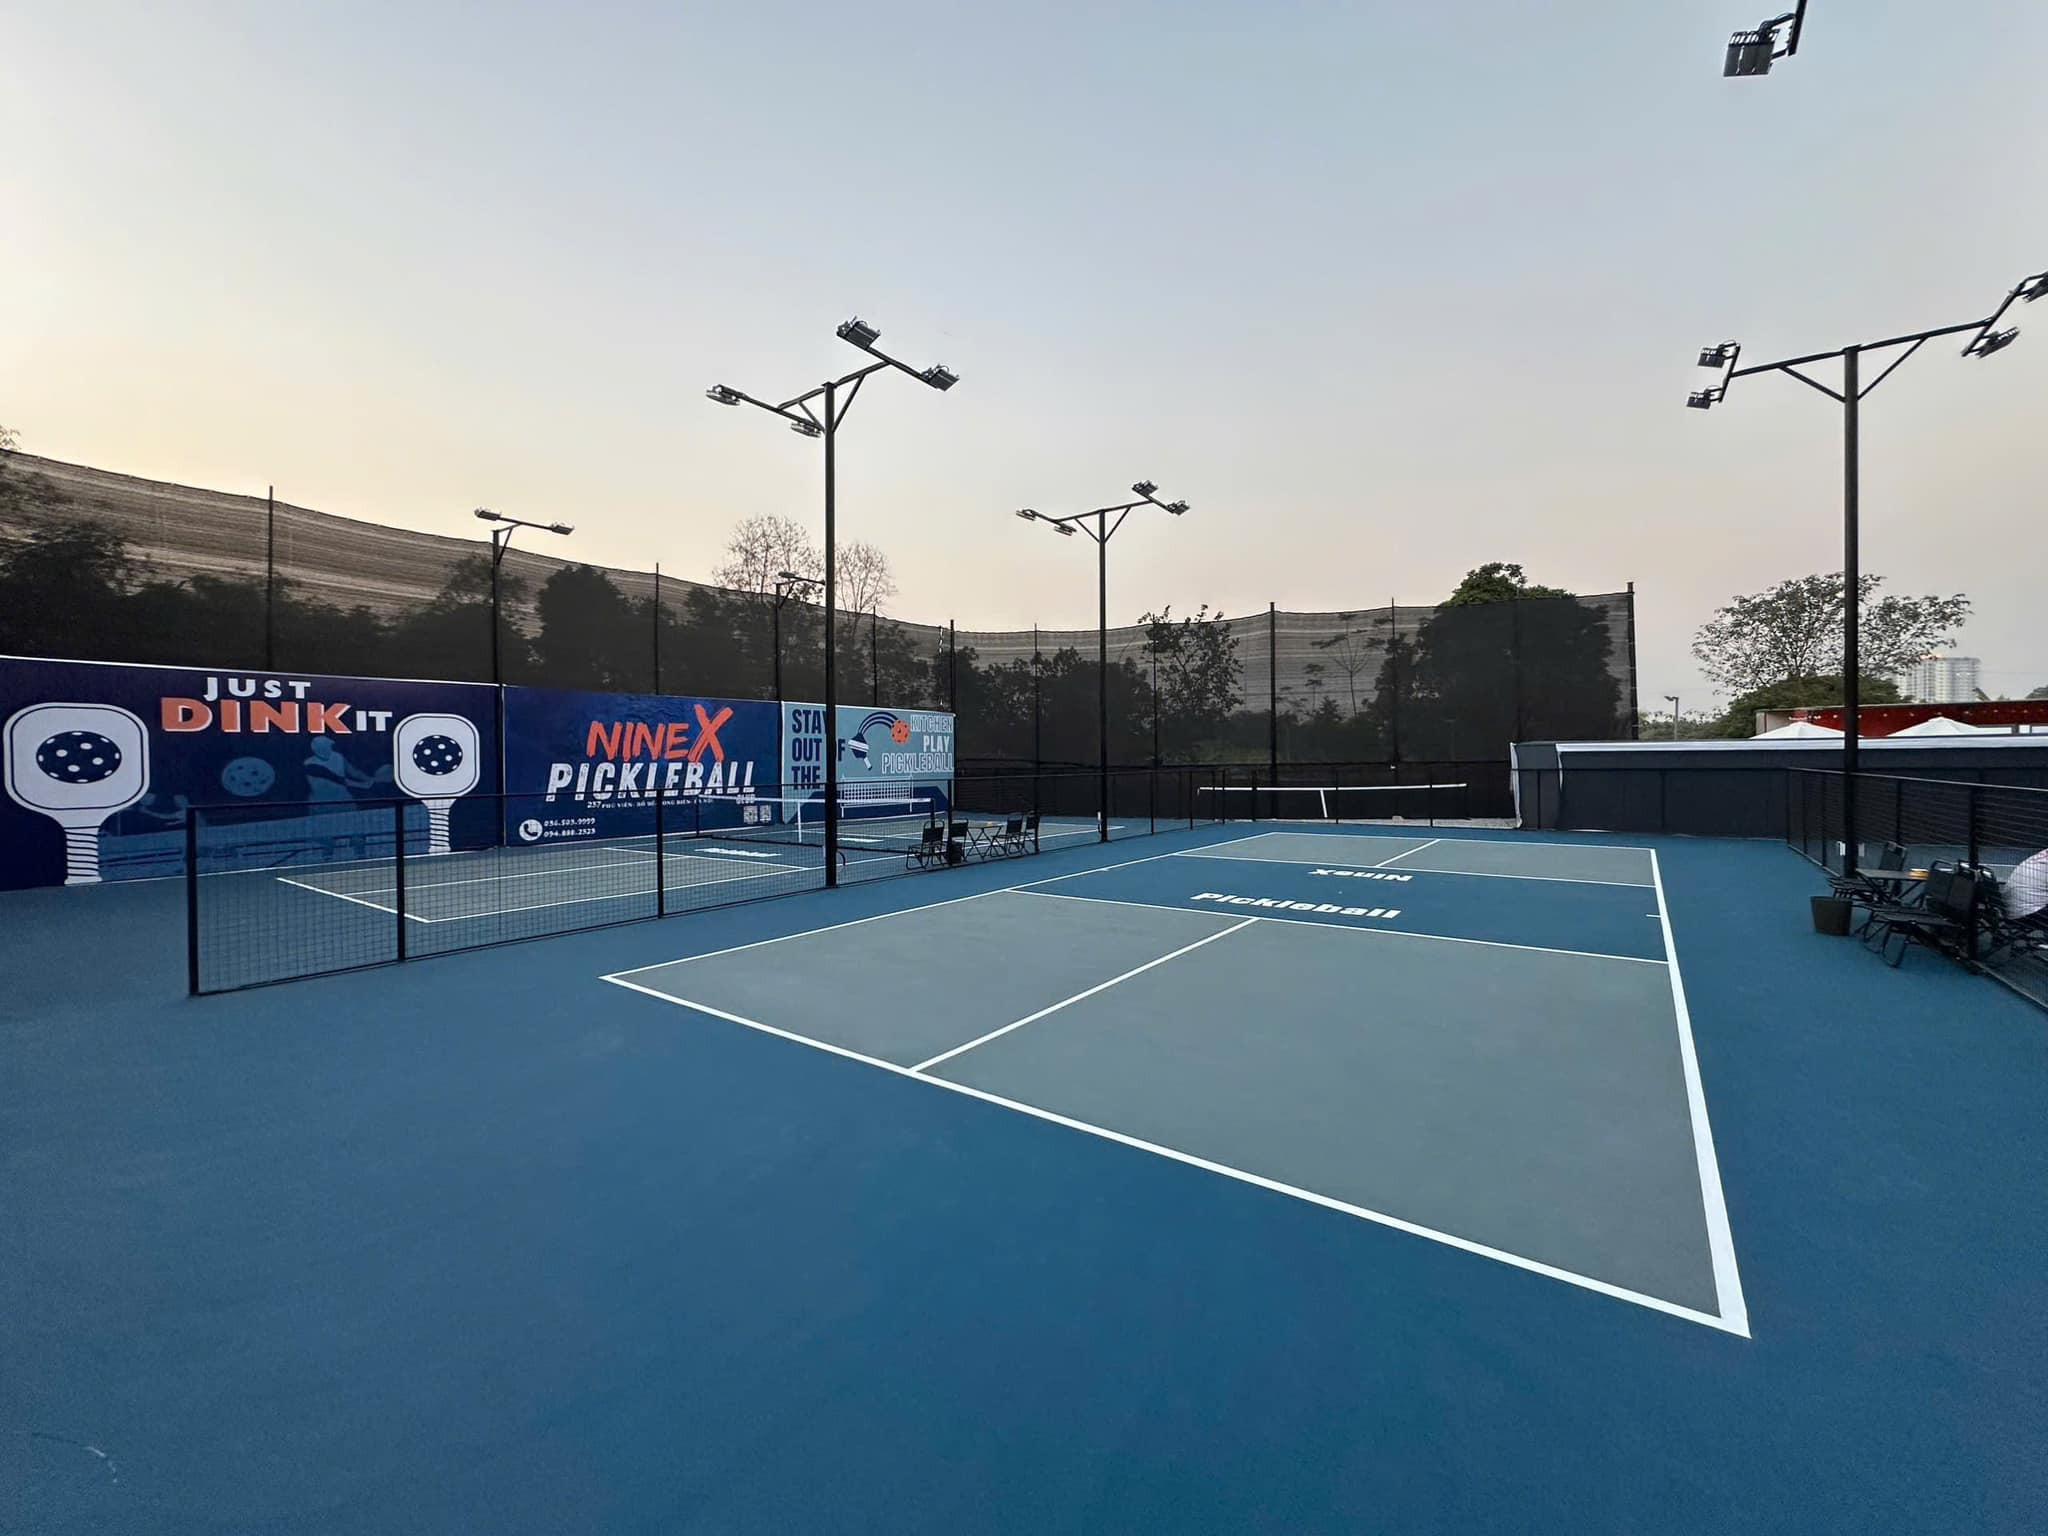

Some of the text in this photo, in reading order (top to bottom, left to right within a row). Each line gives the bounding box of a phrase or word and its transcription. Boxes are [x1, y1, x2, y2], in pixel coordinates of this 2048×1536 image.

[203, 677, 311, 701] JUST
[161, 697, 393, 734] DINK IT
[910, 714, 954, 733] KITCHEN
[586, 703, 734, 763] NINEX
[923, 735, 949, 753] PLAY
[792, 737, 822, 762] OUT
[882, 752, 954, 774] PICKLEBALL
[545, 761, 756, 802] PICKLEBALL
[791, 765, 821, 790] THE
